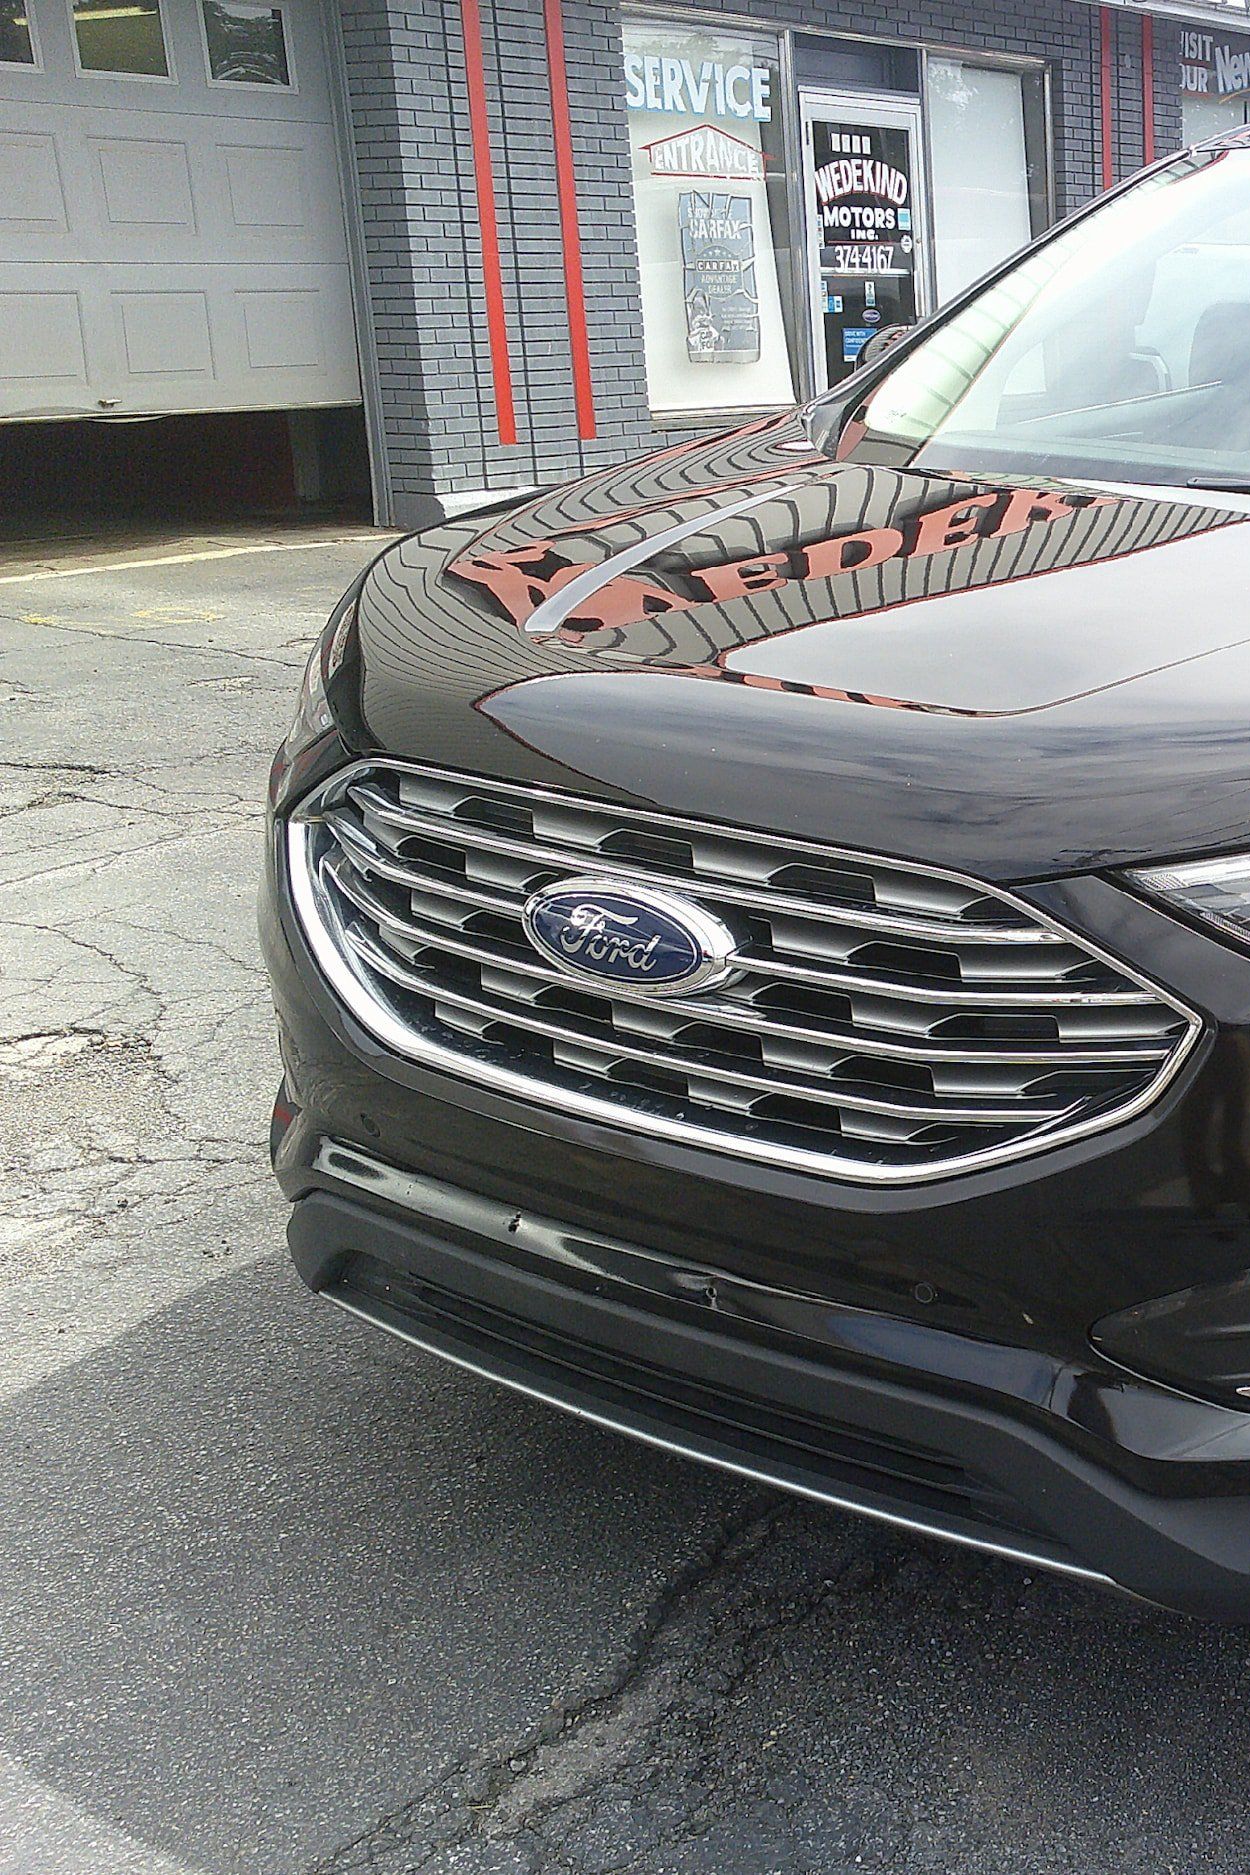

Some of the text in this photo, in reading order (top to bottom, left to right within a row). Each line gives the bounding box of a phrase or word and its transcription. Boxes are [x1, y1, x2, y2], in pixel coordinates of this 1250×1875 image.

[623, 53, 772, 122] SERVICE
[655, 131, 759, 177] ENTRANCE
[815, 158, 908, 205] WEDEKIND
[689, 218, 742, 240] CARFAX
[823, 205, 896, 230] MOTORS
[850, 228, 879, 240] INC.
[697, 260, 740, 271] CARFAX
[834, 245, 894, 274] 374-4167
[560, 902, 663, 972] Ford
